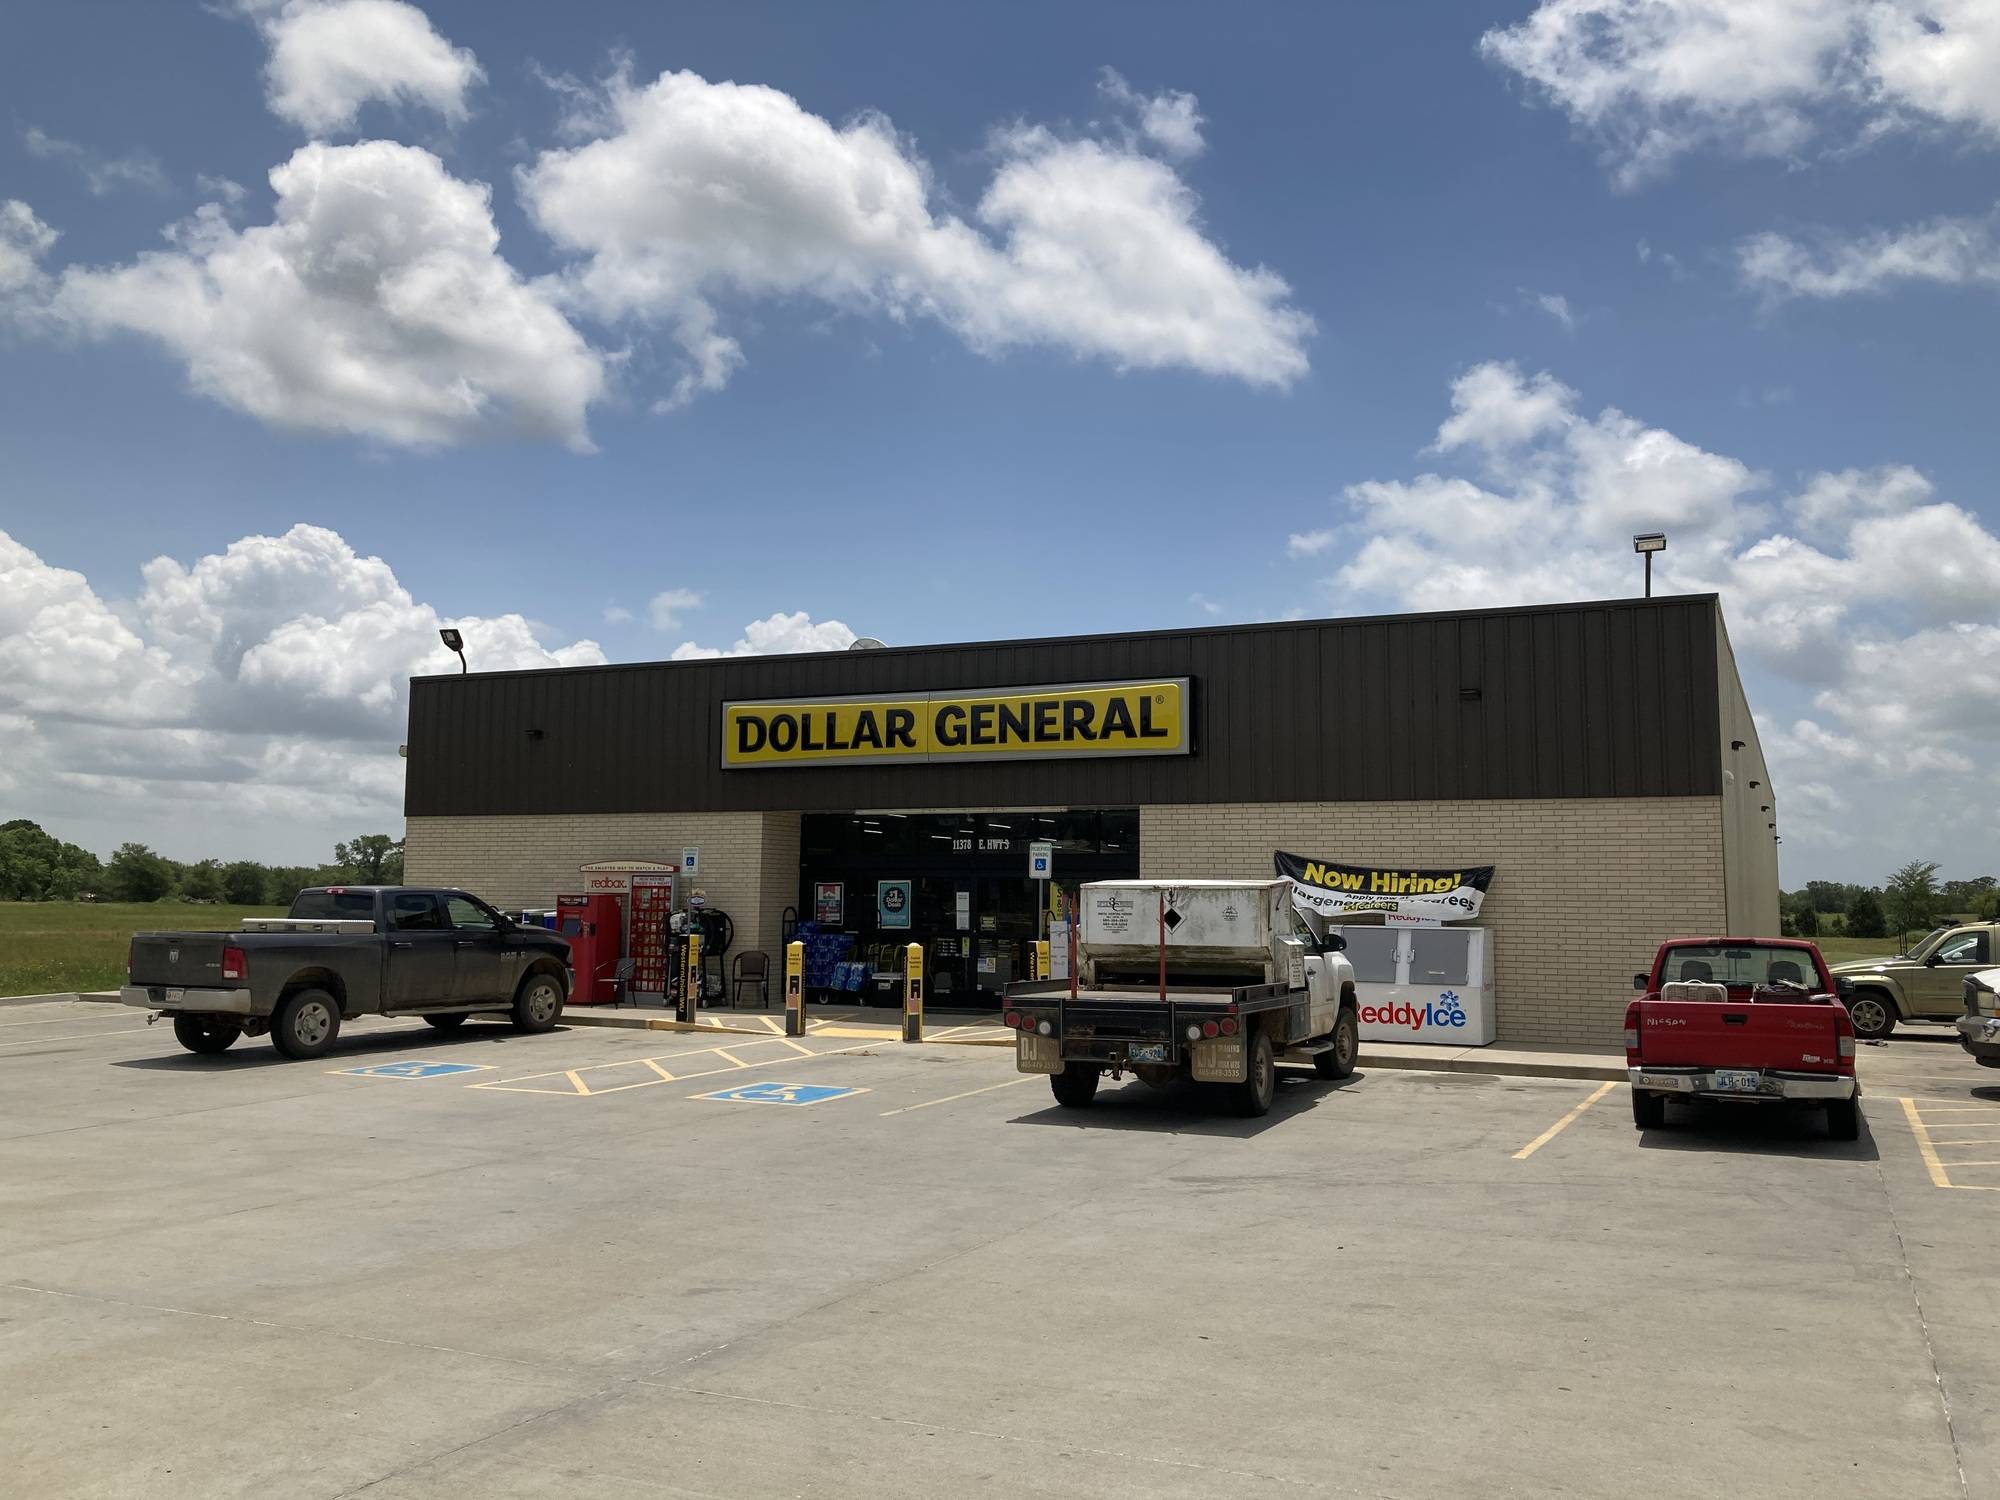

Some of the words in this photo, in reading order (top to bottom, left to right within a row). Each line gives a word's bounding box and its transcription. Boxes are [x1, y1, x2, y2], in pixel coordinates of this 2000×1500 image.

[736, 708, 916, 753] DOLLAR
[952, 838, 972, 850] 11378
[1303, 862, 1364, 890] Now
[1371, 871, 1462, 893] Hiring!
[1345, 893, 1374, 901] Apply
